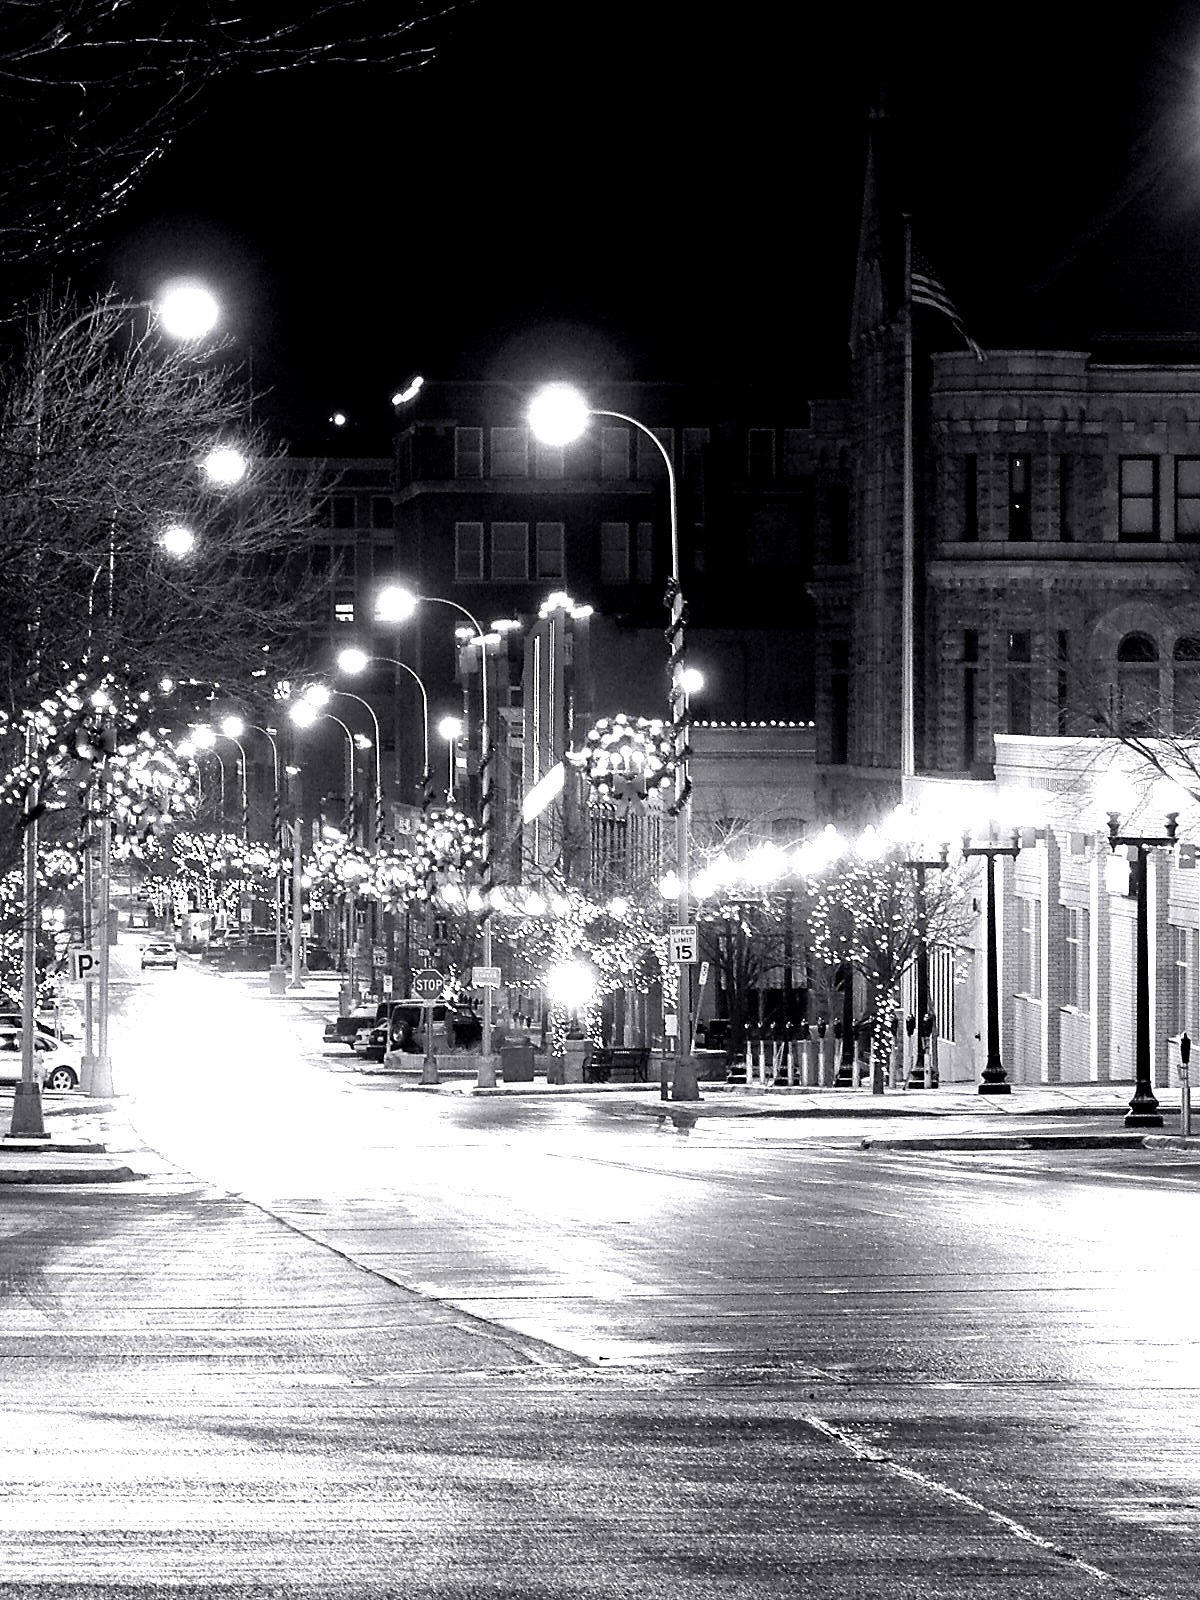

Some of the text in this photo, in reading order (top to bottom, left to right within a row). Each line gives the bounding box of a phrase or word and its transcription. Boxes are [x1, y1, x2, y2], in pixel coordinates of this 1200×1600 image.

[676, 945, 692, 960] 15
[79, 954, 93, 979] P
[416, 979, 443, 991] STOP
